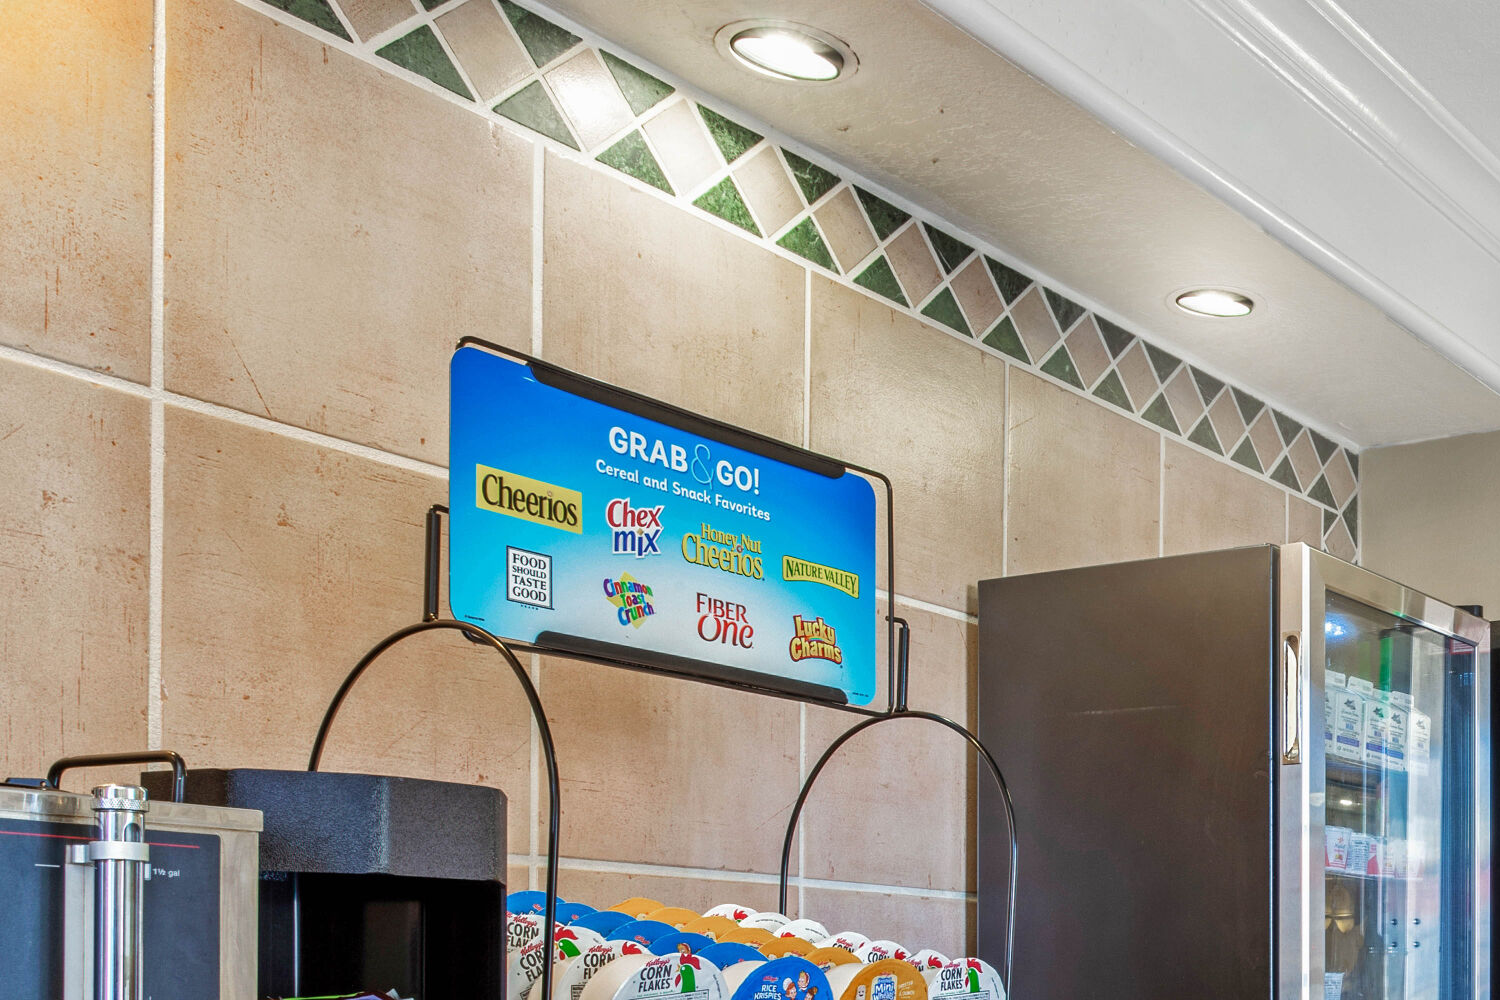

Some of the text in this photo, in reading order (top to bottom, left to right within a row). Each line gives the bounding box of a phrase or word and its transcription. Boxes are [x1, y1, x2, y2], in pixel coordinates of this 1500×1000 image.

[609, 426, 761, 496] GRAB & GO!
[481, 473, 578, 527] Cheerios
[595, 459, 771, 522] Cereal and Snack Favorites
[606, 499, 662, 529] Chex
[614, 530, 661, 557] mix
[701, 522, 763, 555] Honey Nut
[512, 553, 546, 570] FOOD
[681, 532, 764, 580] Cheerios
[512, 565, 547, 580] SHOULD
[512, 574, 547, 591] TASTE
[786, 558, 857, 595] NATURE VALLEY
[512, 586, 547, 602] GOOD
[603, 578, 653, 599] Cinnamon
[620, 593, 646, 609] Toast
[696, 591, 749, 624] FIBER
[617, 601, 655, 627] Crunch
[697, 614, 755, 649] One
[793, 614, 836, 646] Lucky
[790, 637, 842, 664] Charms
[168, 869, 181, 878] gal
[507, 922, 540, 940] CORN
[520, 950, 544, 970] COR
[640, 965, 672, 981] CORN
[940, 968, 963, 981] CORN
[638, 977, 671, 993] FLAKES
[761, 984, 778, 994] RICE
[874, 980, 895, 994] Mini
[940, 979, 963, 992] FLAKES
